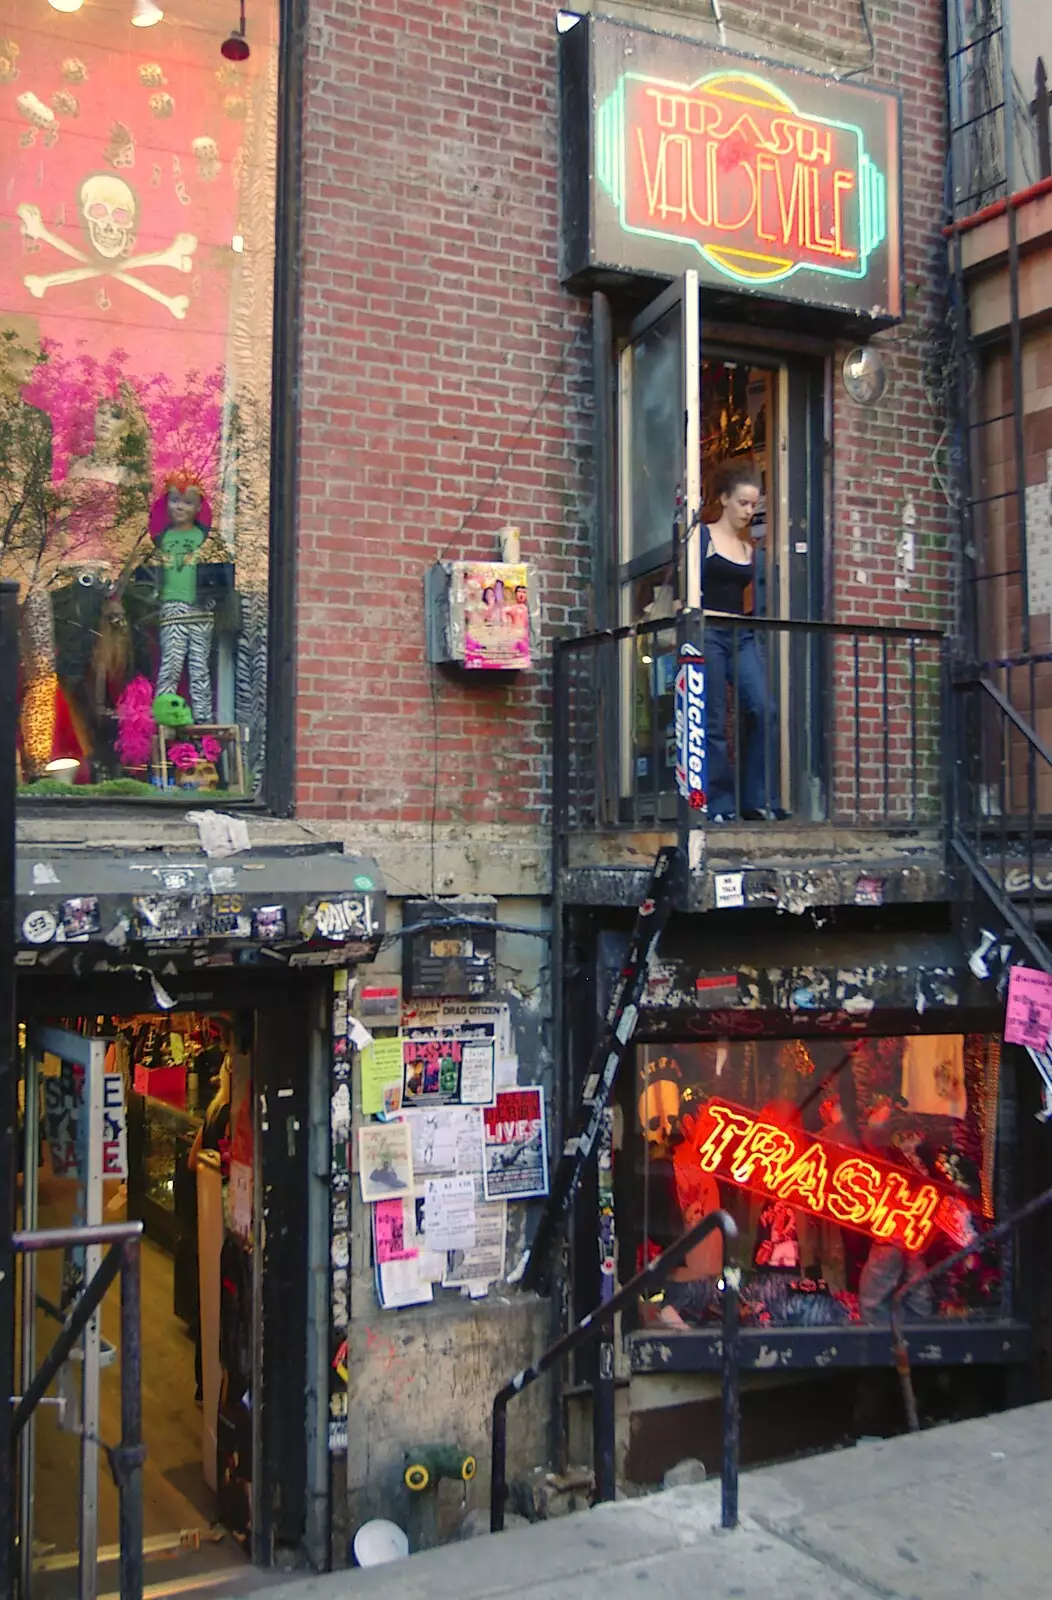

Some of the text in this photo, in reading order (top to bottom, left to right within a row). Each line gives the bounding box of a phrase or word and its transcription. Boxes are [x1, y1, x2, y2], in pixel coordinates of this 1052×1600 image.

[645, 88, 832, 165] TRASH
[636, 127, 857, 259] VAUDEVILLE
[443, 1005, 500, 1016] DRAG CITIZEN
[486, 1118, 543, 1144] LIVES
[700, 1105, 940, 1251] TRASH
